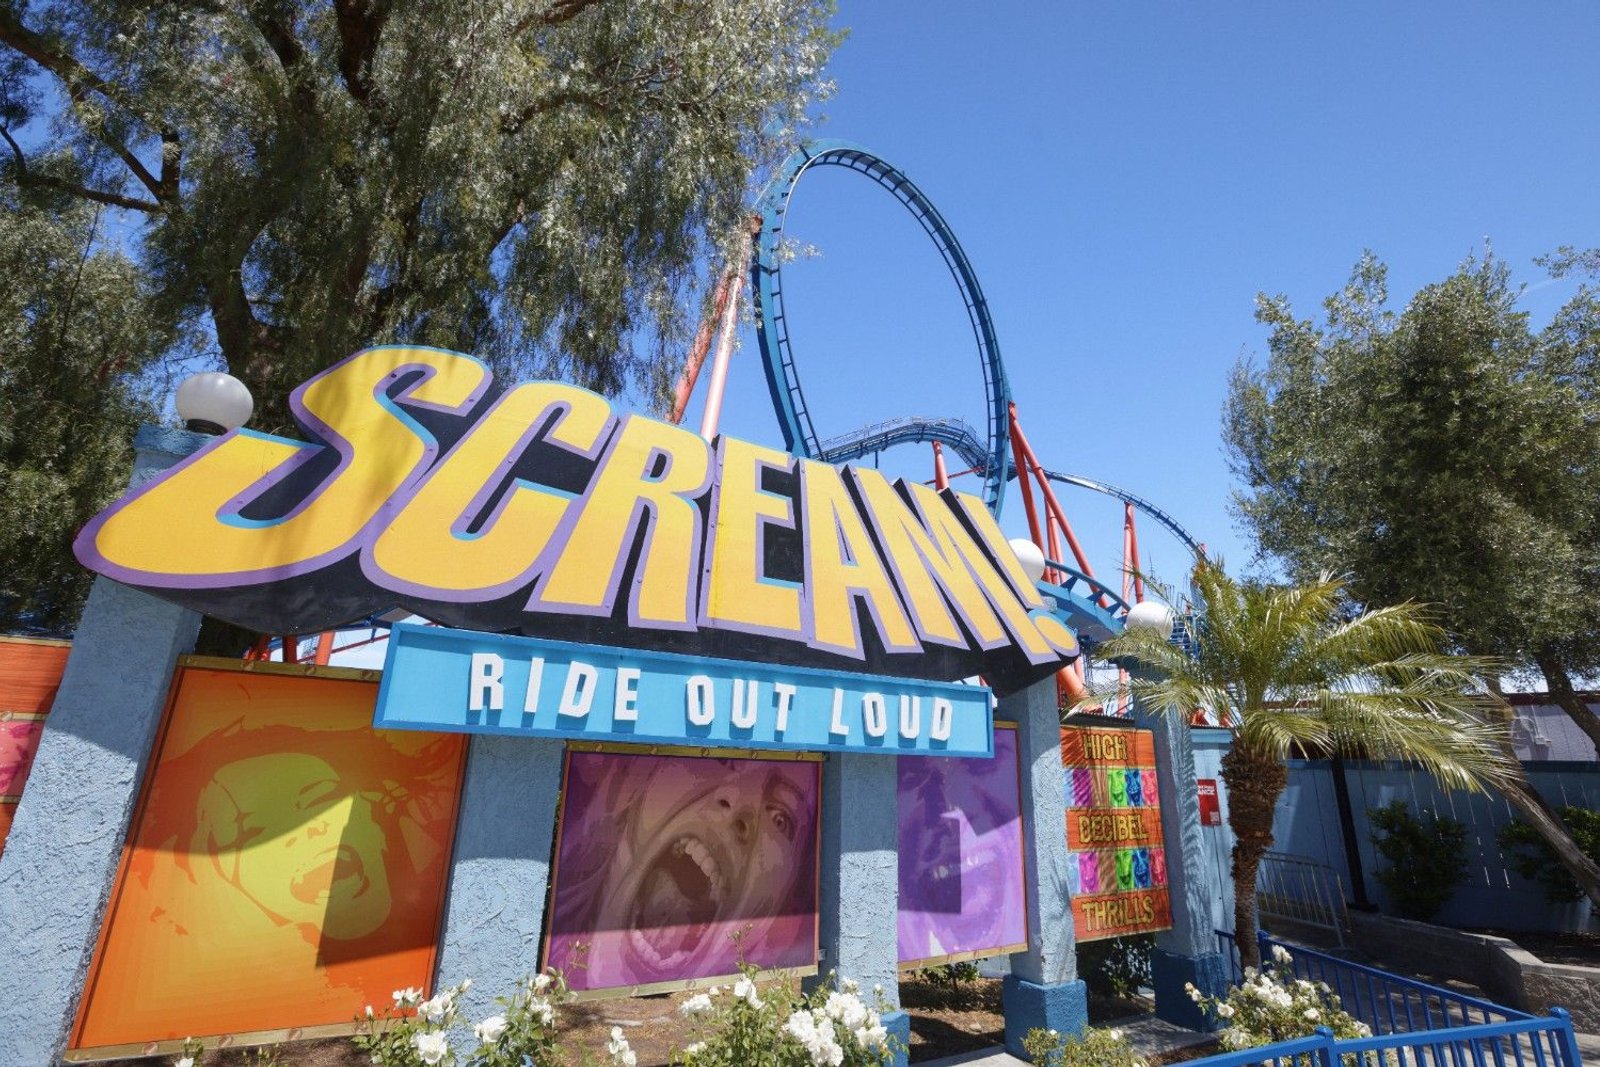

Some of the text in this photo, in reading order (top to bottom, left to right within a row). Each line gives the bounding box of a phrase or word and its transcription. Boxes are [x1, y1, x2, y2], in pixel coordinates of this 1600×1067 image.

[72, 344, 1080, 665] SCREAM!
[469, 653, 954, 741] RIDE OUT LOUD
[1082, 734, 1128, 761] HIGH
[1077, 814, 1150, 844] DECIBEL
[1081, 896, 1155, 931] THRILLS
